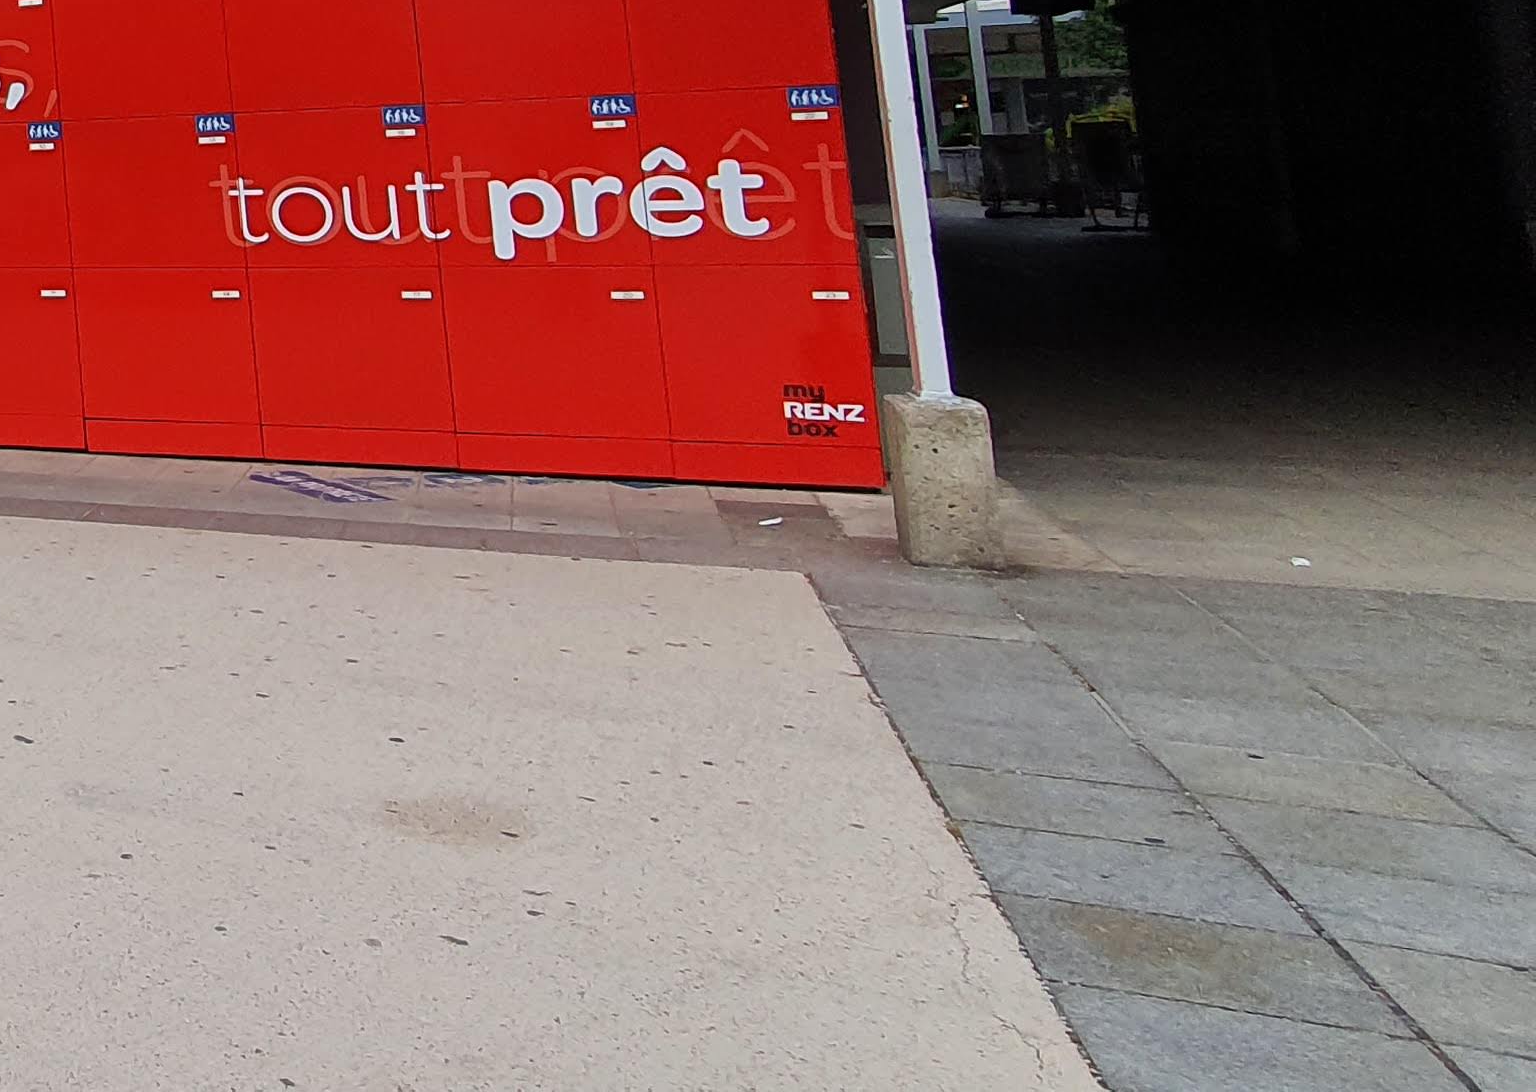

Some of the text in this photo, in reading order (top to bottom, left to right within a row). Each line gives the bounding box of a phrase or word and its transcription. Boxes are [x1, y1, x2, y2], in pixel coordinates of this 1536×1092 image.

[227, 146, 770, 261] tout prêt
[783, 384, 825, 403] my
[783, 401, 865, 423] RENZ
[787, 419, 840, 438] box
